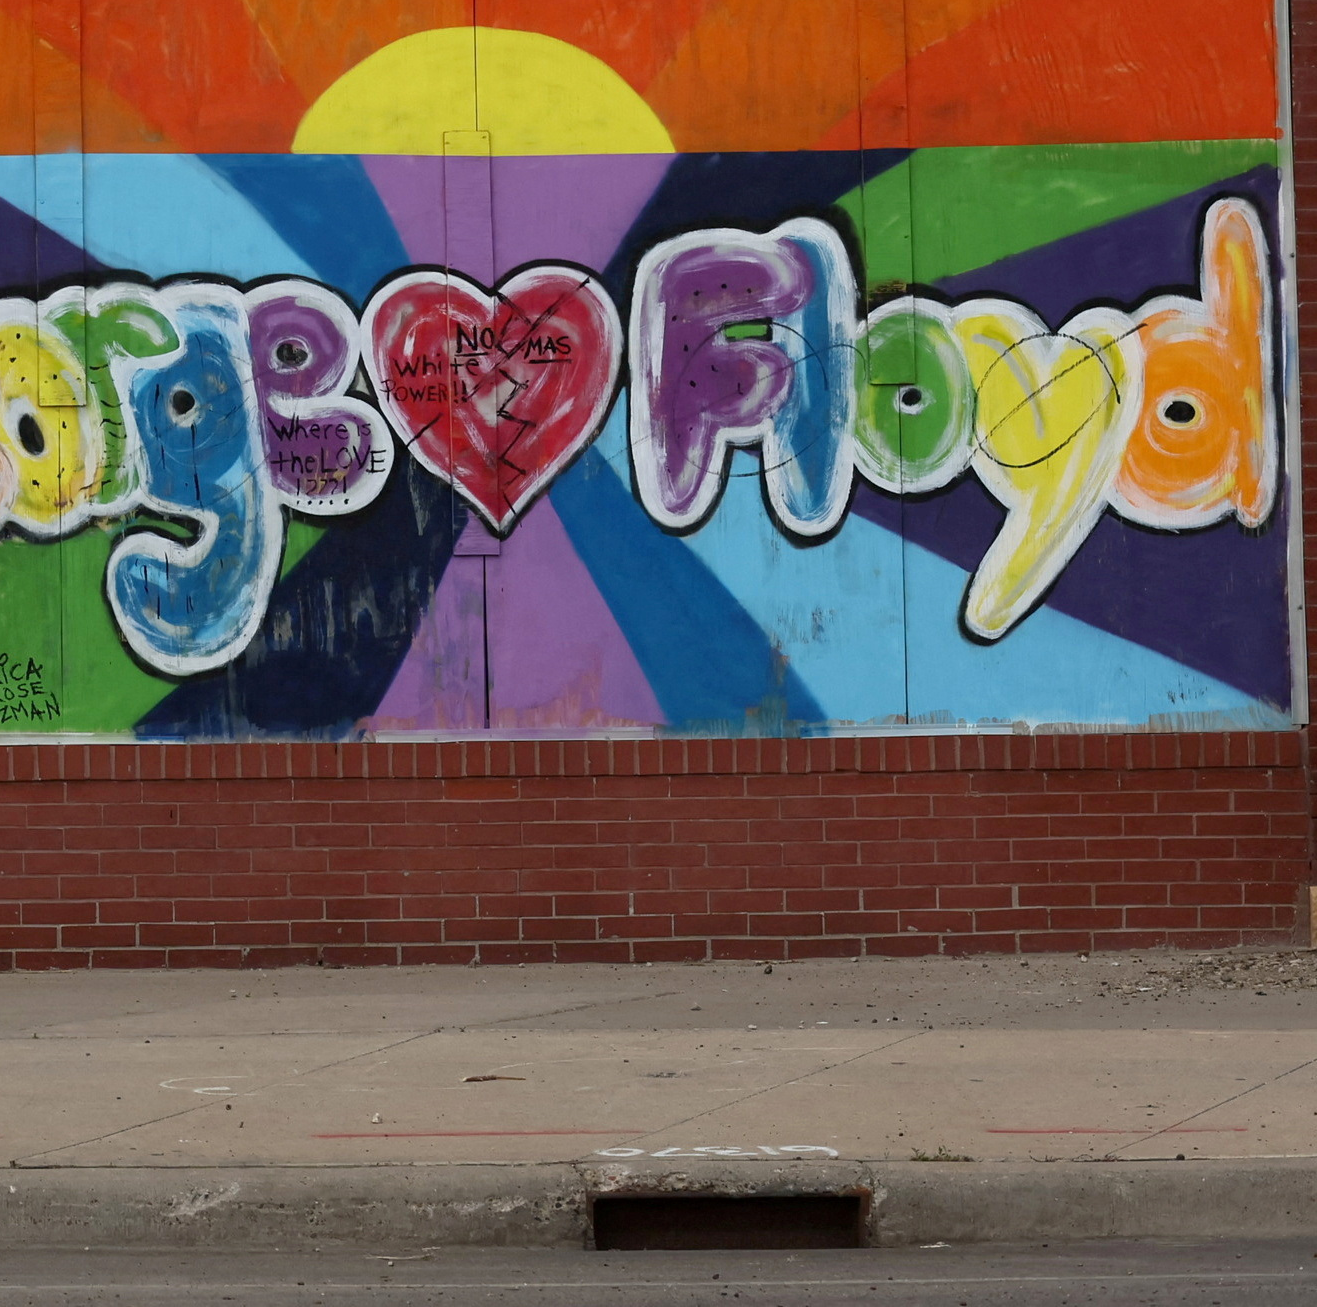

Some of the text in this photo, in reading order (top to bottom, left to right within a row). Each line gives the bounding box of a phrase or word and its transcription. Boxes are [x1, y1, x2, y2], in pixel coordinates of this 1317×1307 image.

[456, 326, 572, 360] NO MAS
[267, 412, 372, 442] Where is
[630, 195, 1277, 641] Floyd
[270, 445, 387, 474] the LOVE
